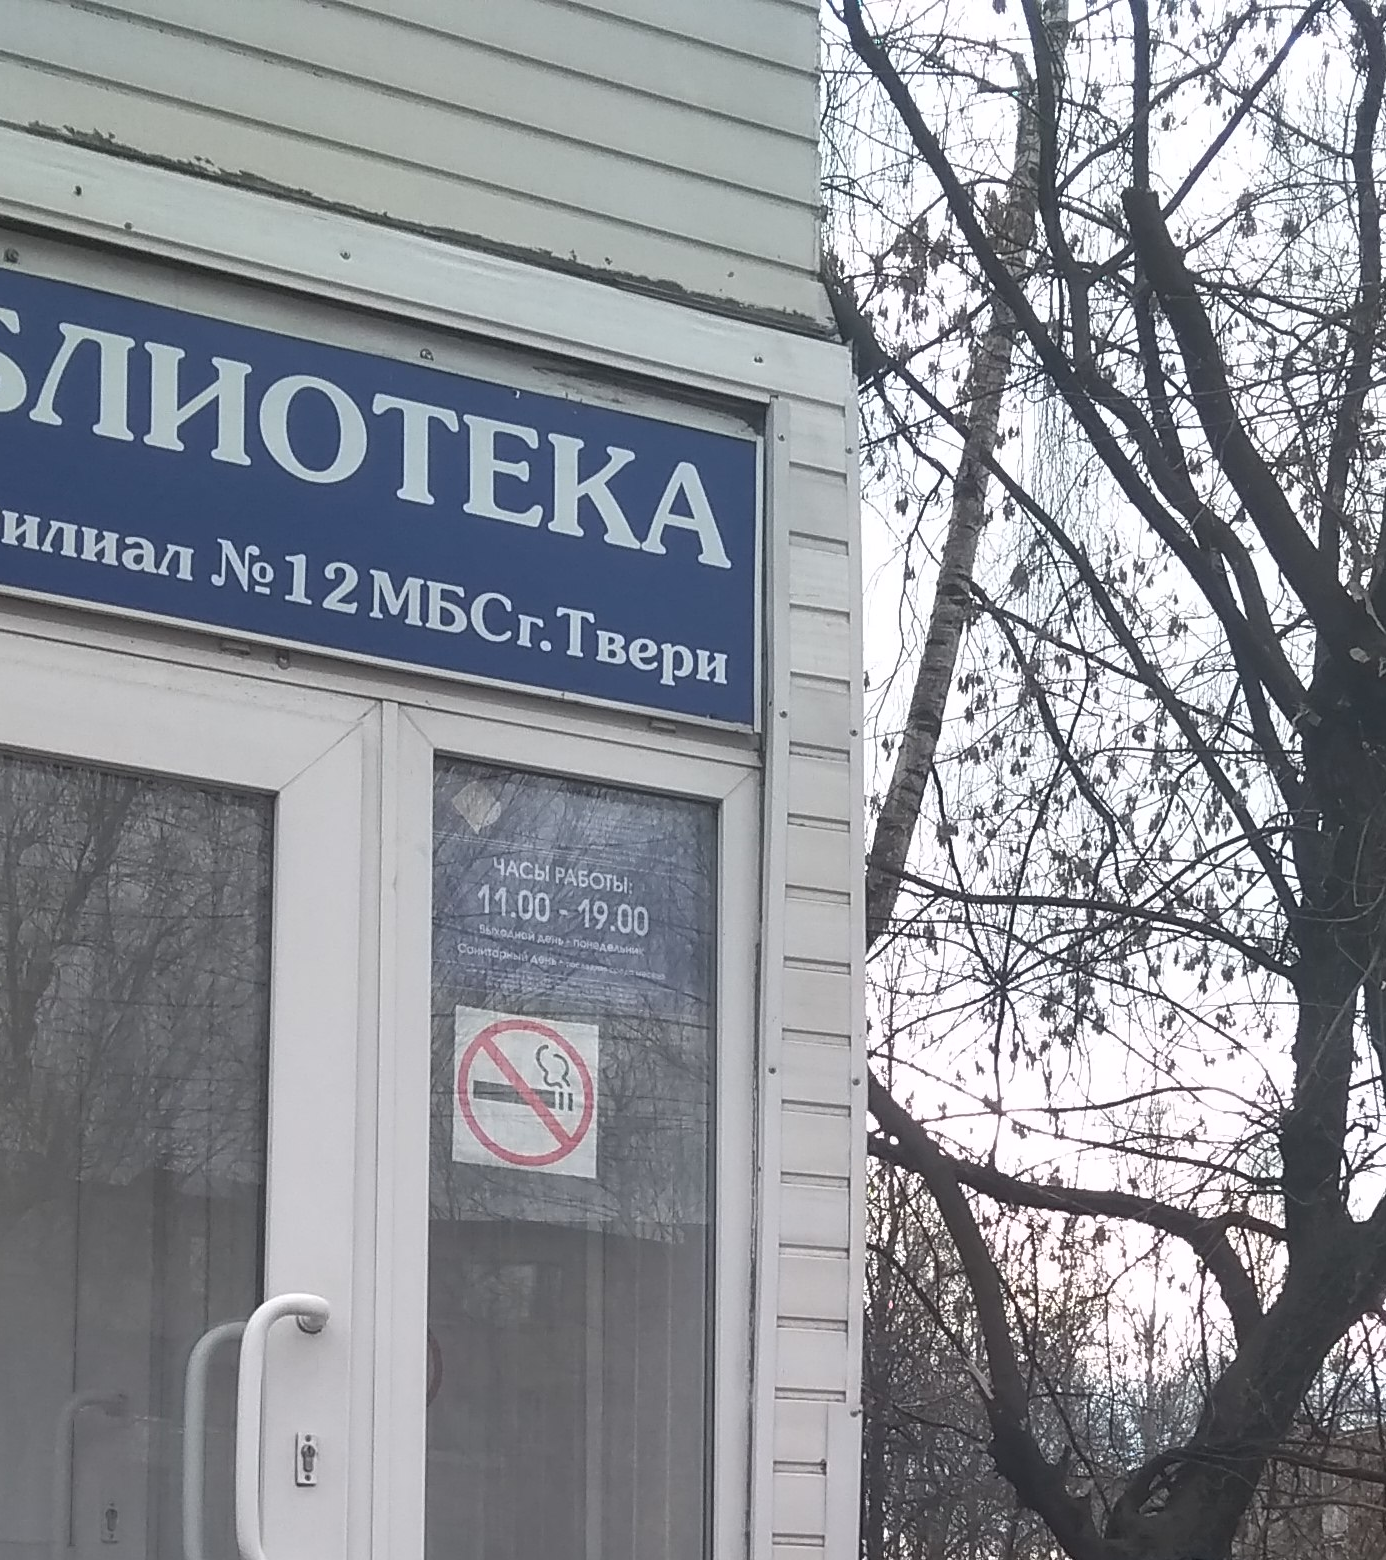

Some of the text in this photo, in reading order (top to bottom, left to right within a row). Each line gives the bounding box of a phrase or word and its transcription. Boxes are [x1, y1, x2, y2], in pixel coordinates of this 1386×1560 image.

[493, 856, 633, 895] ЧАСЫ РАБОТЫ:
[477, 884, 550, 922] 11.00
[577, 898, 650, 936] 19.00
[537, 933, 564, 946] день
